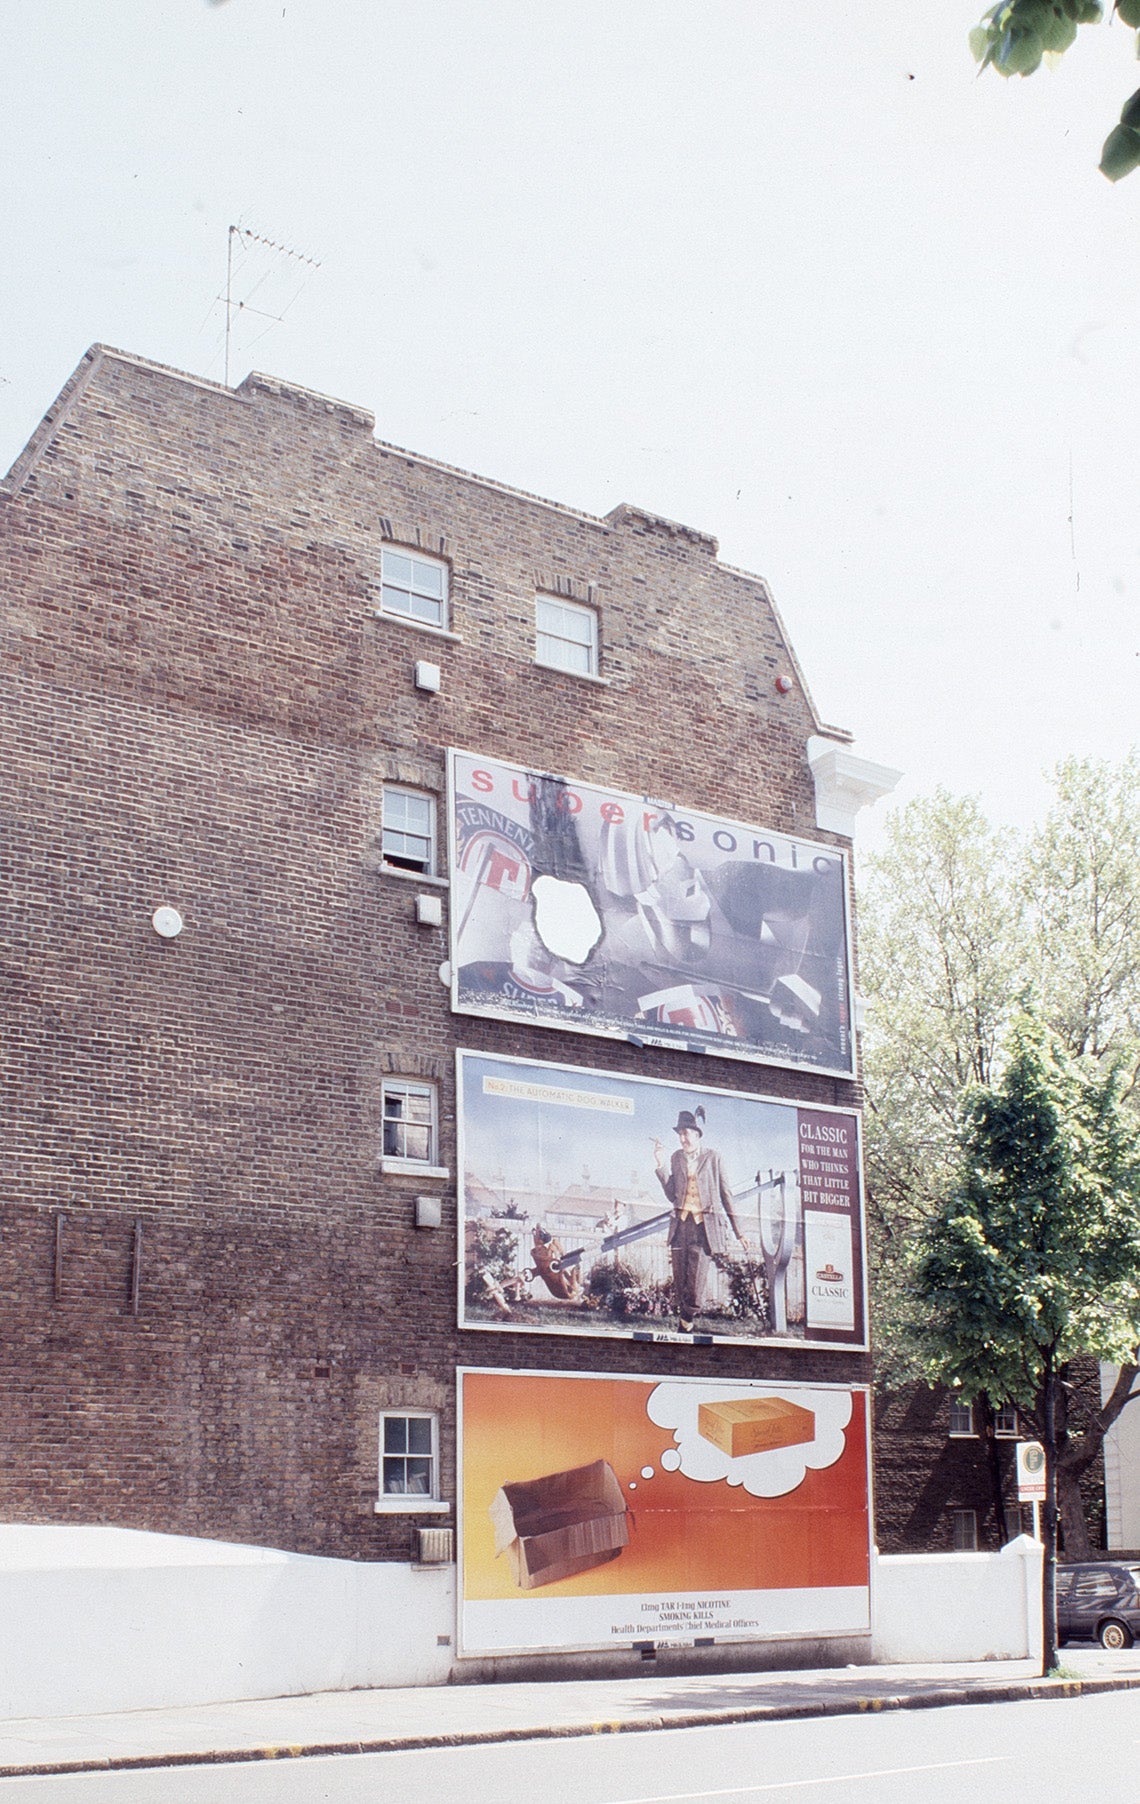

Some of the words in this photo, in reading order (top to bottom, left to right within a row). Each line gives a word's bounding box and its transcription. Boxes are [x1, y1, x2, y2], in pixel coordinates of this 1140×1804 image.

[527, 1087, 575, 1102] AUTOMATIC
[800, 1123, 847, 1144] CLASSIC
[801, 1143, 815, 1155] FOR
[816, 1145, 831, 1156] THE
[832, 1147, 848, 1158] MAN
[802, 1159, 819, 1170] WHO
[820, 1161, 849, 1174] THINKS
[802, 1175, 822, 1187] THAT
[824, 1177, 850, 1190] LITTLE
[803, 1190, 818, 1203] BIT
[820, 1192, 850, 1207] BIGGER
[812, 1286, 849, 1299] CLASSIC
[661, 1602, 675, 1610] TAR
[697, 1600, 731, 1609] NICOTINE
[693, 1611, 714, 1620] KILLS
[611, 1624, 635, 1634] Health
[704, 1619, 732, 1629] Medical
[733, 1618, 760, 1628] Officers
